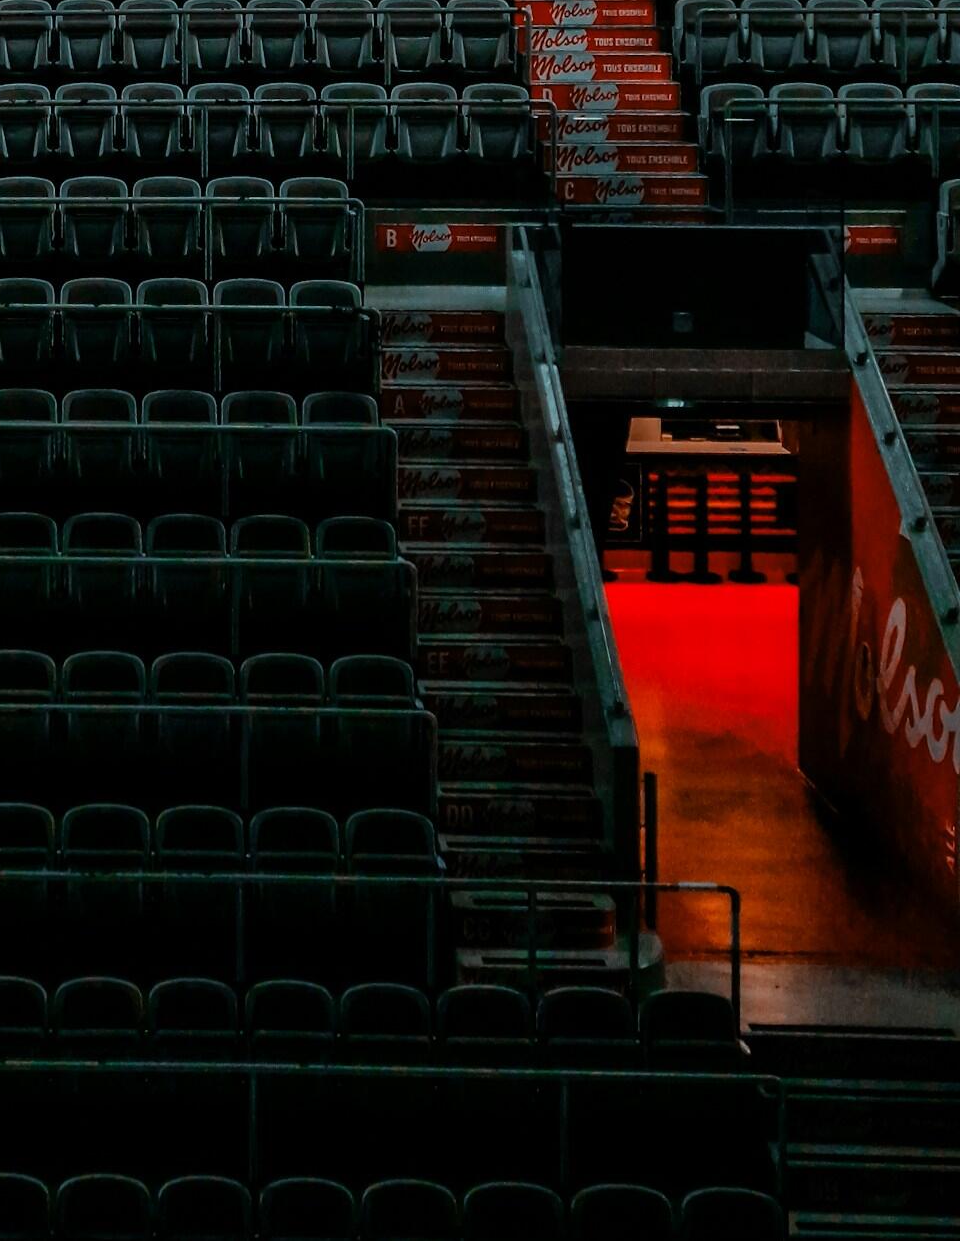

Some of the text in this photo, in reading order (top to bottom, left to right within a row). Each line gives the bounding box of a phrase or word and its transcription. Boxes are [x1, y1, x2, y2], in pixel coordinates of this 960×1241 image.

[594, 38, 613, 46] TOUS
[603, 64, 622, 72] TOUS
[565, 182, 575, 199] C
[386, 229, 397, 247] B
[394, 395, 406, 414] A
